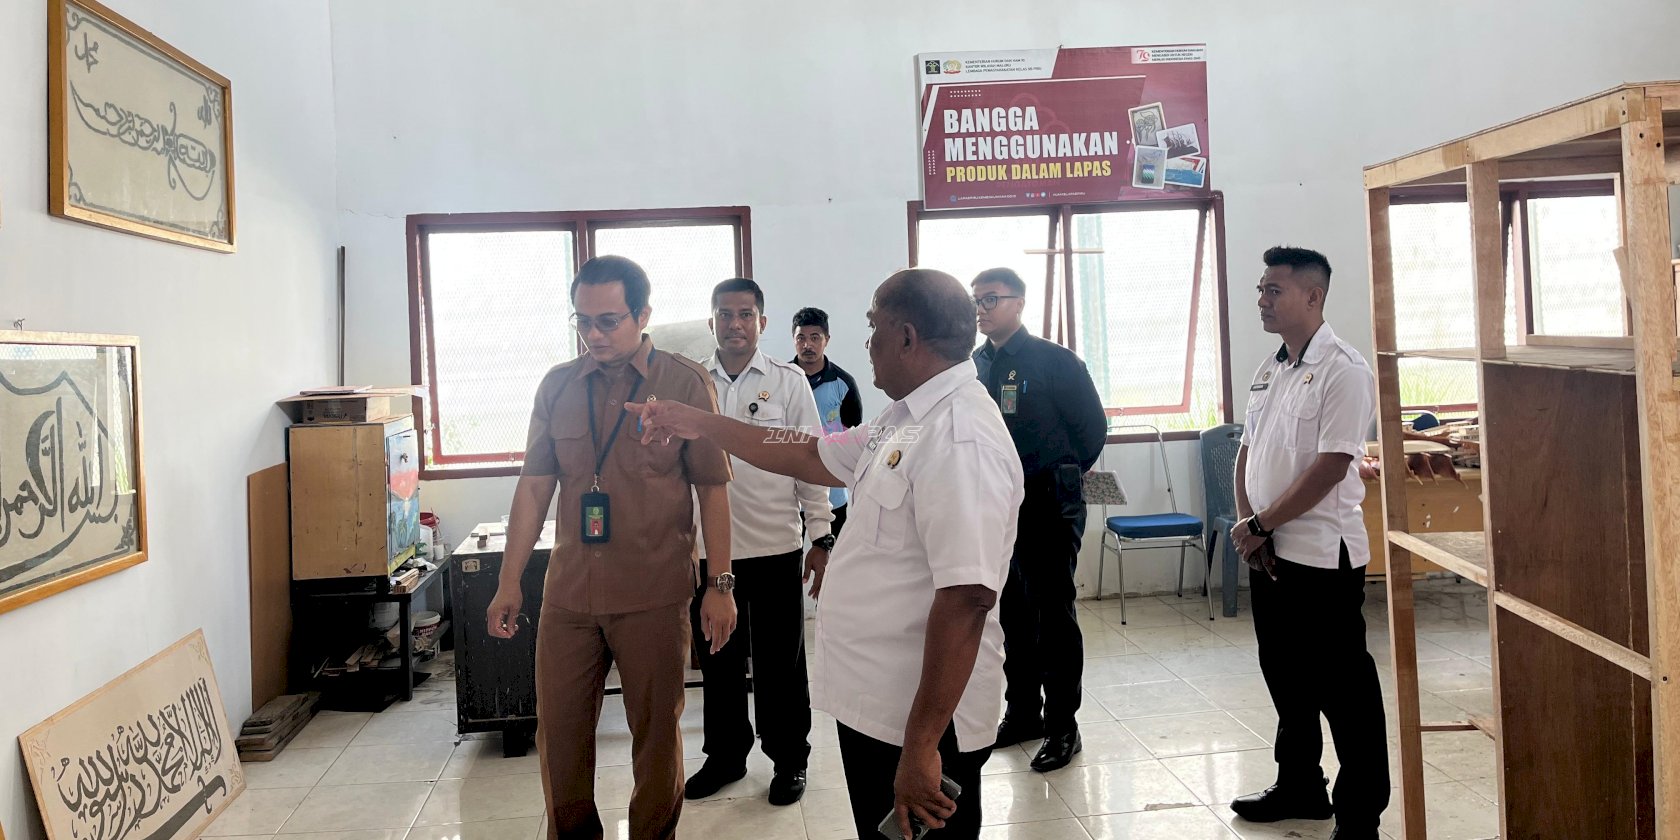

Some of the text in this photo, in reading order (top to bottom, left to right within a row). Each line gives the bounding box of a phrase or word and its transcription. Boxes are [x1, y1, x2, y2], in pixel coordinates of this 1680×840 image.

[943, 106, 1040, 133] BANGGA
[944, 131, 1119, 162] MENGGUNAKAN
[946, 160, 1112, 183] PRODUK DALAM LAPAS
